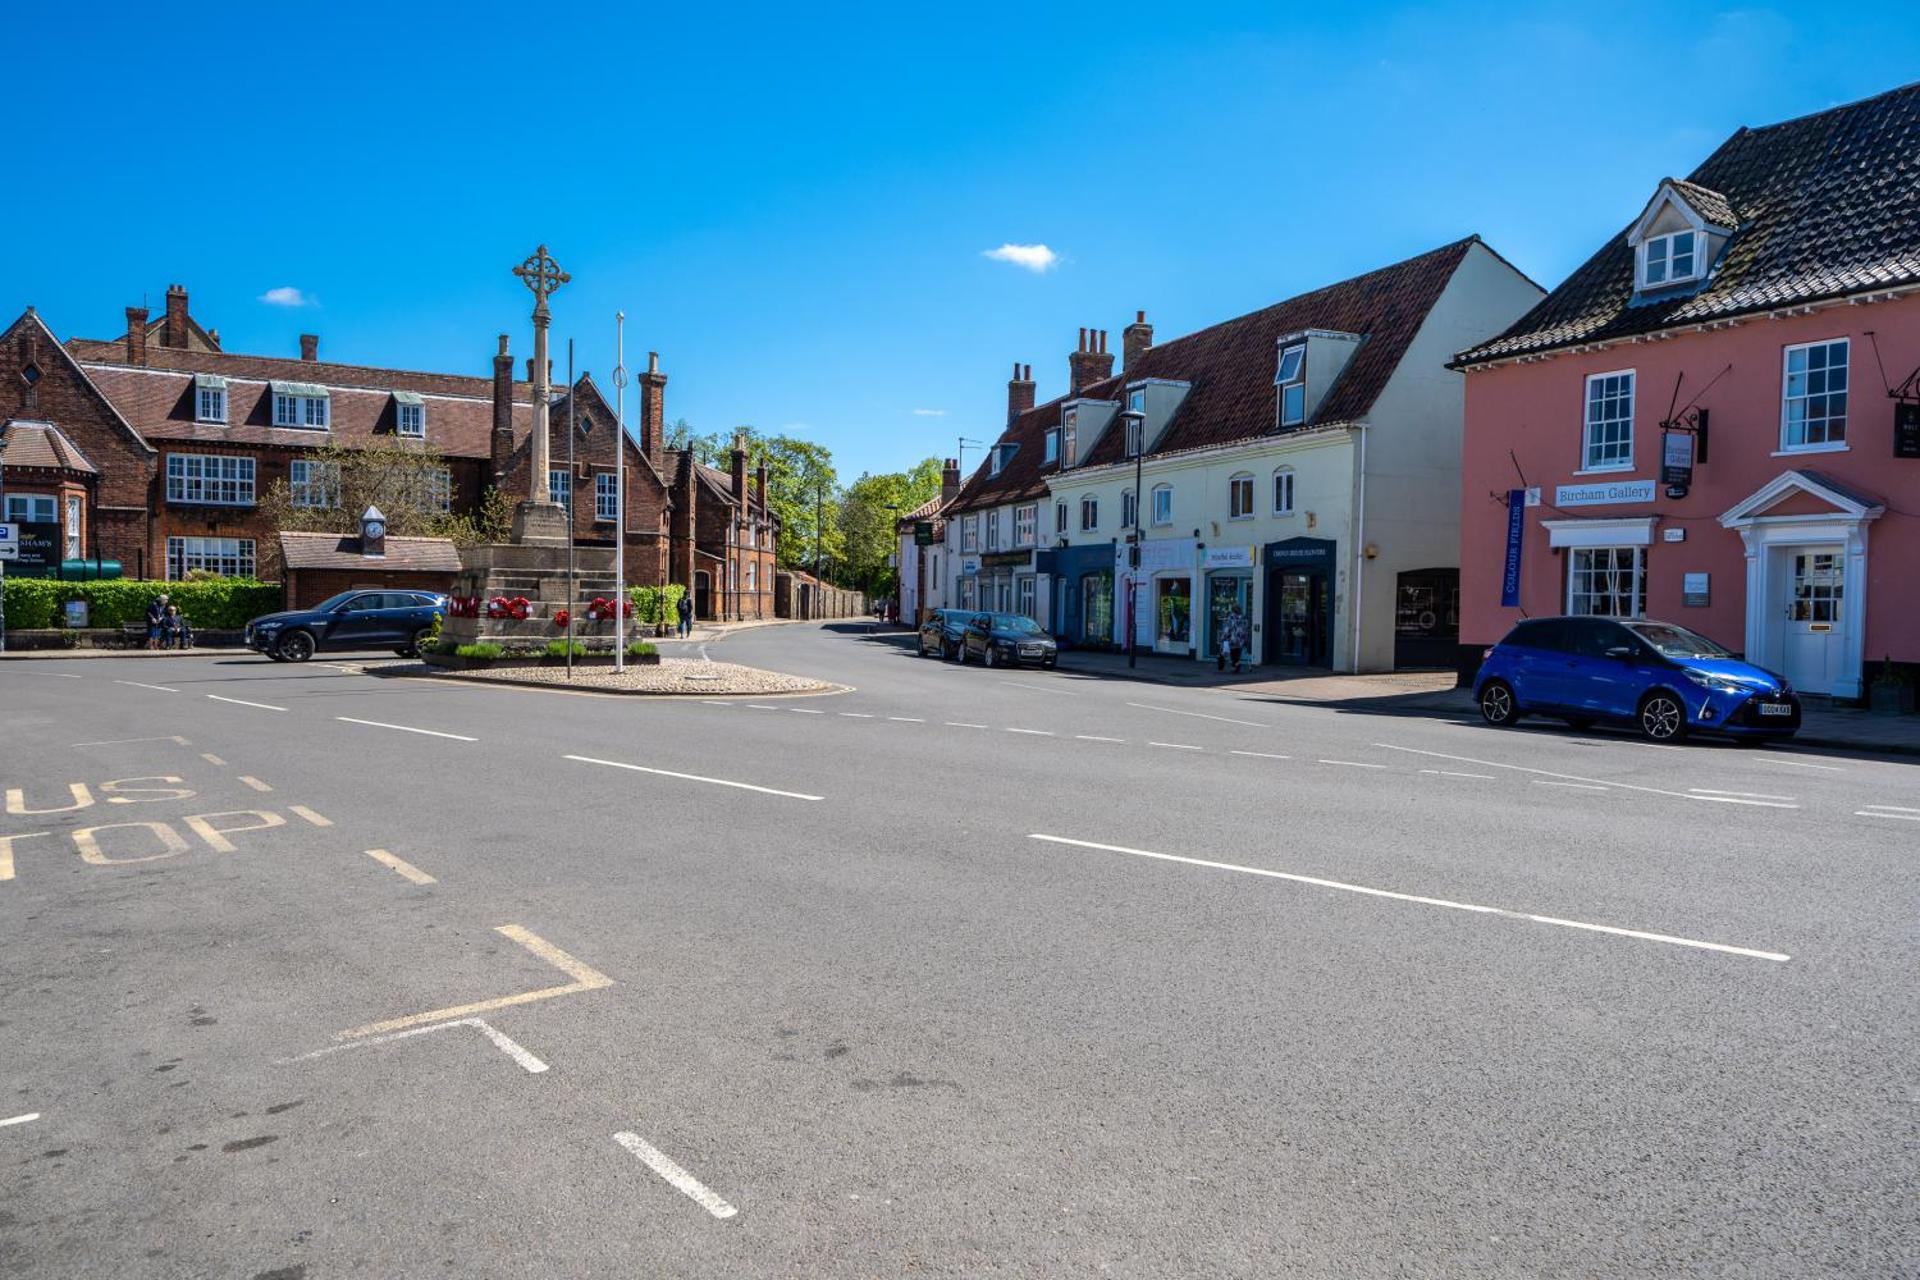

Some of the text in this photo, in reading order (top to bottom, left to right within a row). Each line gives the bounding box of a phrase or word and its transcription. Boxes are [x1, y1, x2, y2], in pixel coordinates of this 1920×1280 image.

[1560, 486, 1651, 502] Bircham Gallery
[1506, 506, 1520, 593] COLOUR FIELDS
[5, 775, 197, 815] US
[0, 809, 288, 881] TOP
